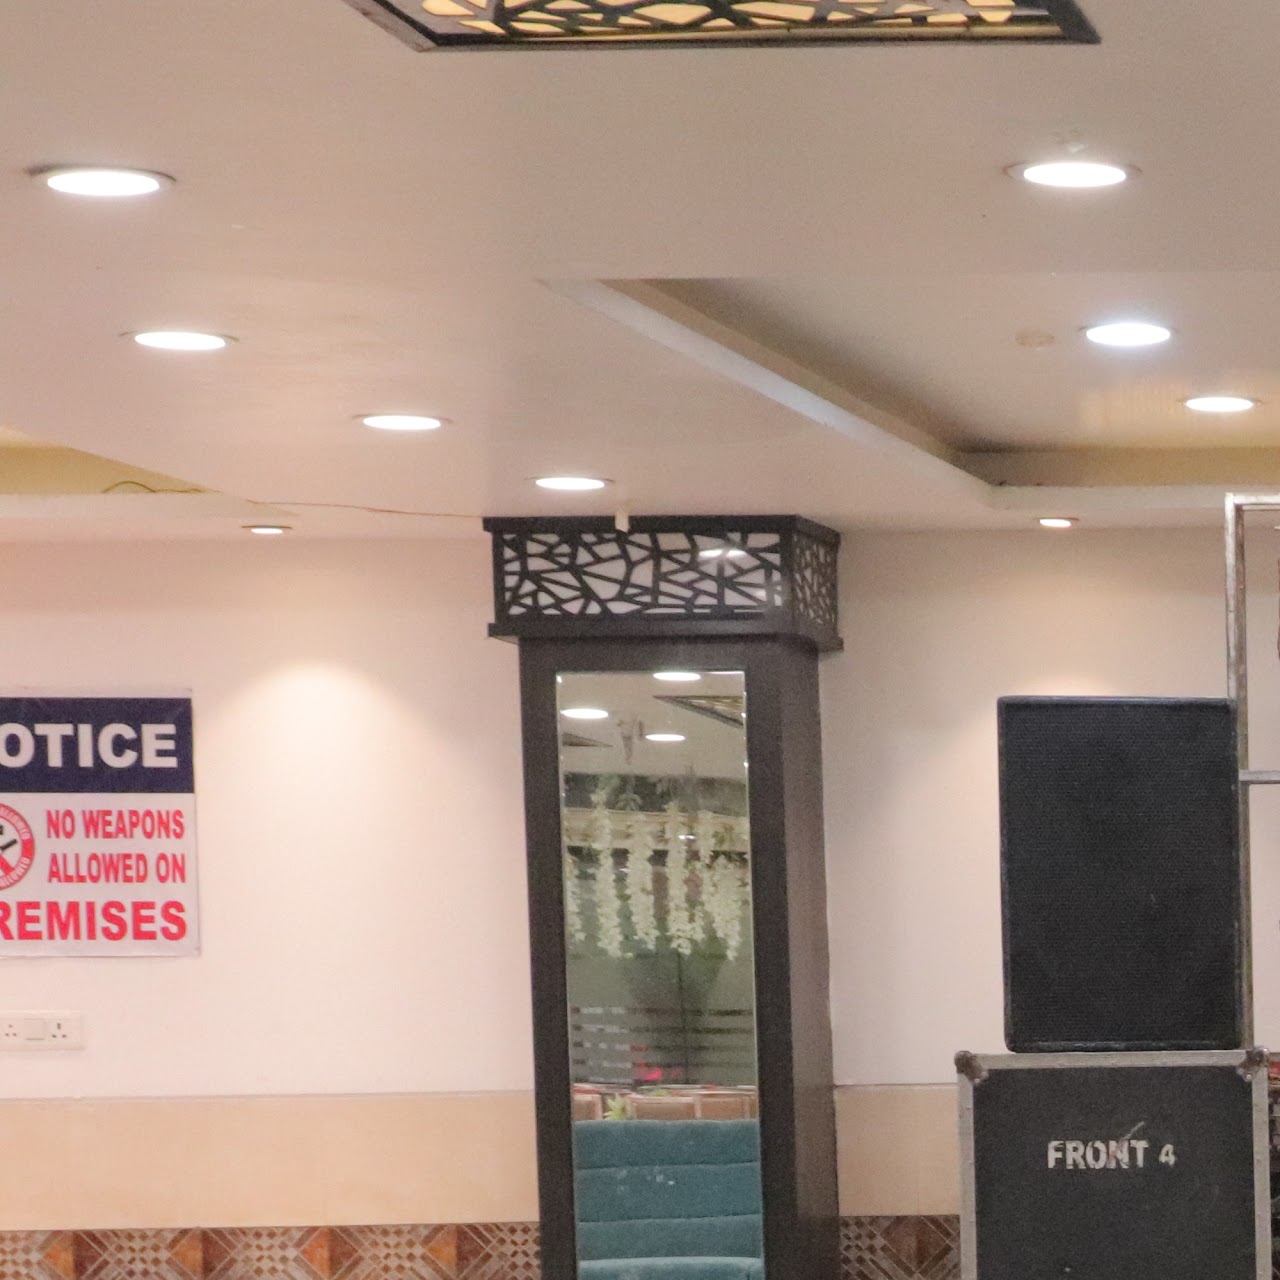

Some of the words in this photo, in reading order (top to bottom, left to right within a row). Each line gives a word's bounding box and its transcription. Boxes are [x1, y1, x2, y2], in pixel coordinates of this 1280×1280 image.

[0, 723, 178, 768] OTICE
[46, 809, 75, 839] NO
[82, 809, 185, 839] WEAPONS
[48, 852, 148, 883] ALLOWED
[156, 852, 186, 883] ON
[1047, 1139, 1149, 1169] FRONT
[1158, 1144, 1177, 1168] 4
